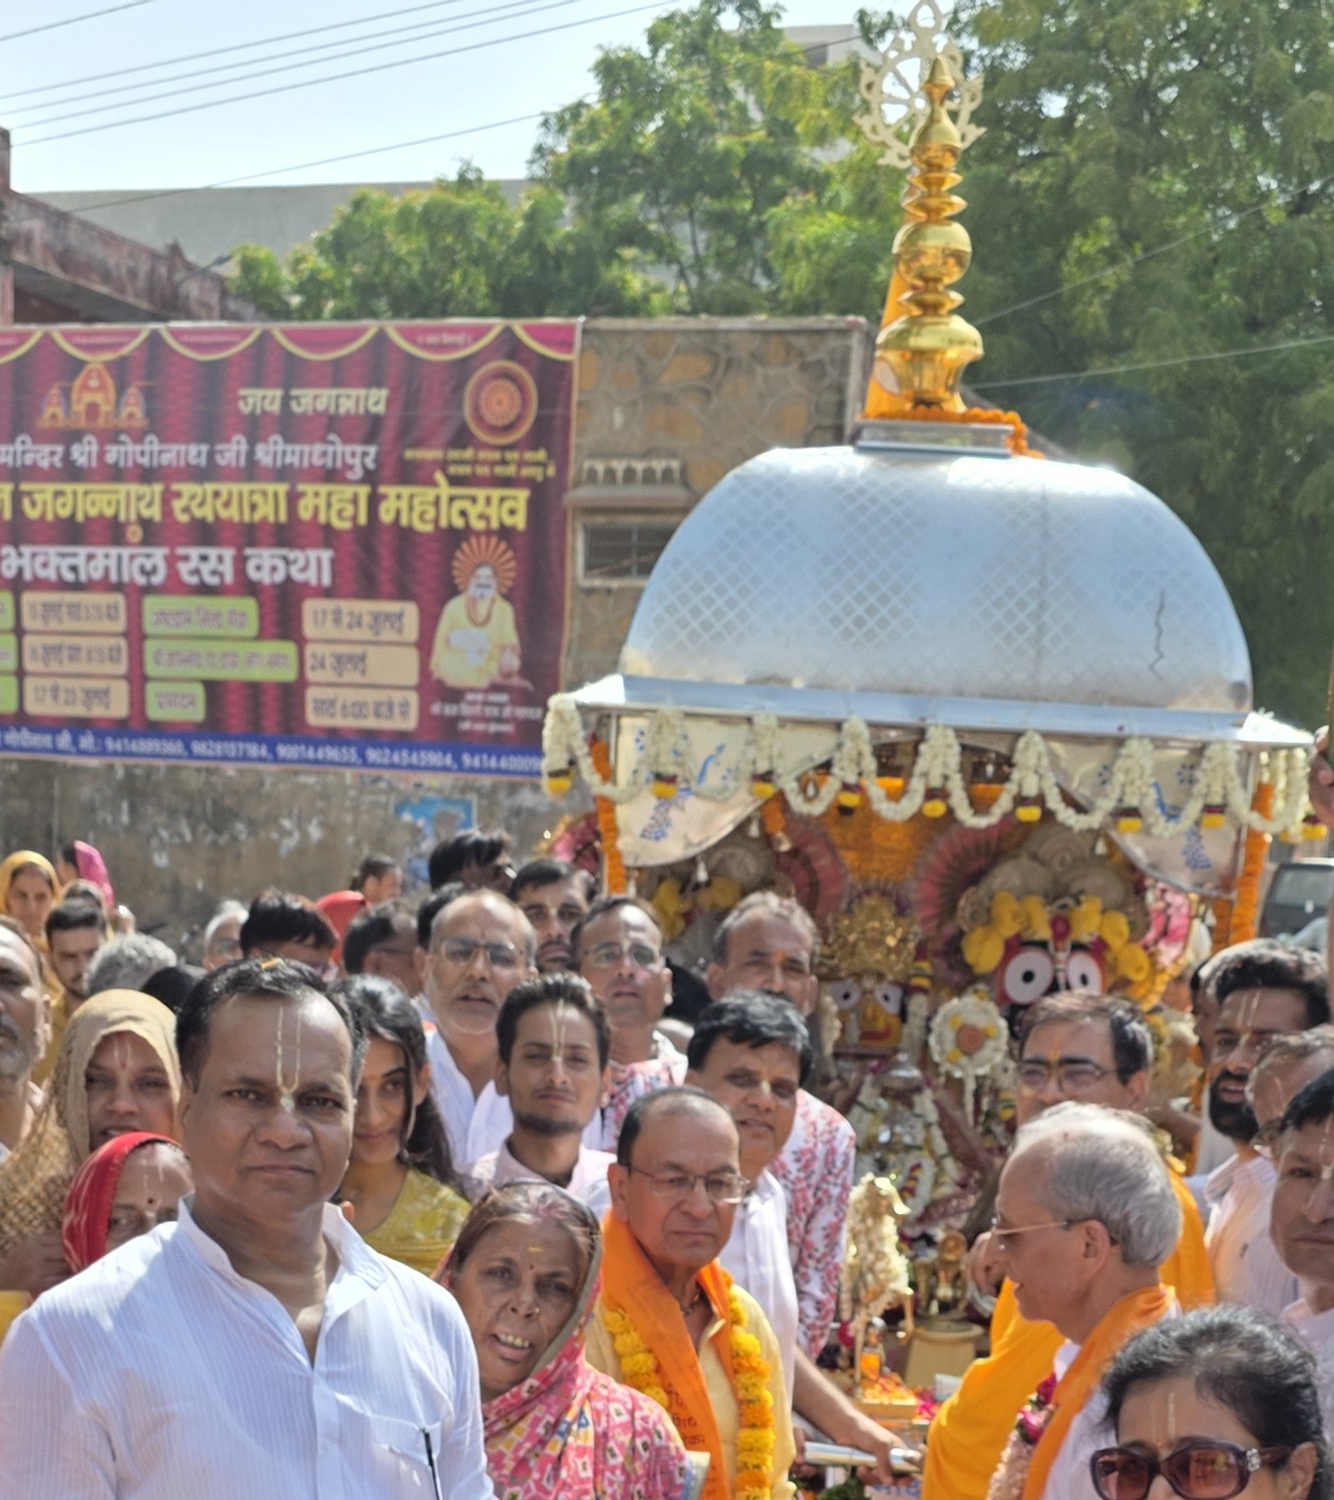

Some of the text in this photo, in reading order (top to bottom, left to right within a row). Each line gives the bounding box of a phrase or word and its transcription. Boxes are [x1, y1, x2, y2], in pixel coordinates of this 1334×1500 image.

[237, 387, 390, 417] जय जगन्नाथ
[69, 434, 100, 468] श्री
[105, 434, 209, 469] गोपीनाथ
[214, 434, 249, 469] जी
[253, 434, 379, 480] श्रीमाधोपुर
[19, 480, 164, 524] जगन्नाथ
[171, 481, 290, 525] रथयात्रा
[297, 481, 371, 531] महा
[378, 470, 532, 532] महोत्सव
[0, 543, 169, 587] भक्तमाल
[175, 545, 236, 586] रस
[244, 546, 333, 588] कथा
